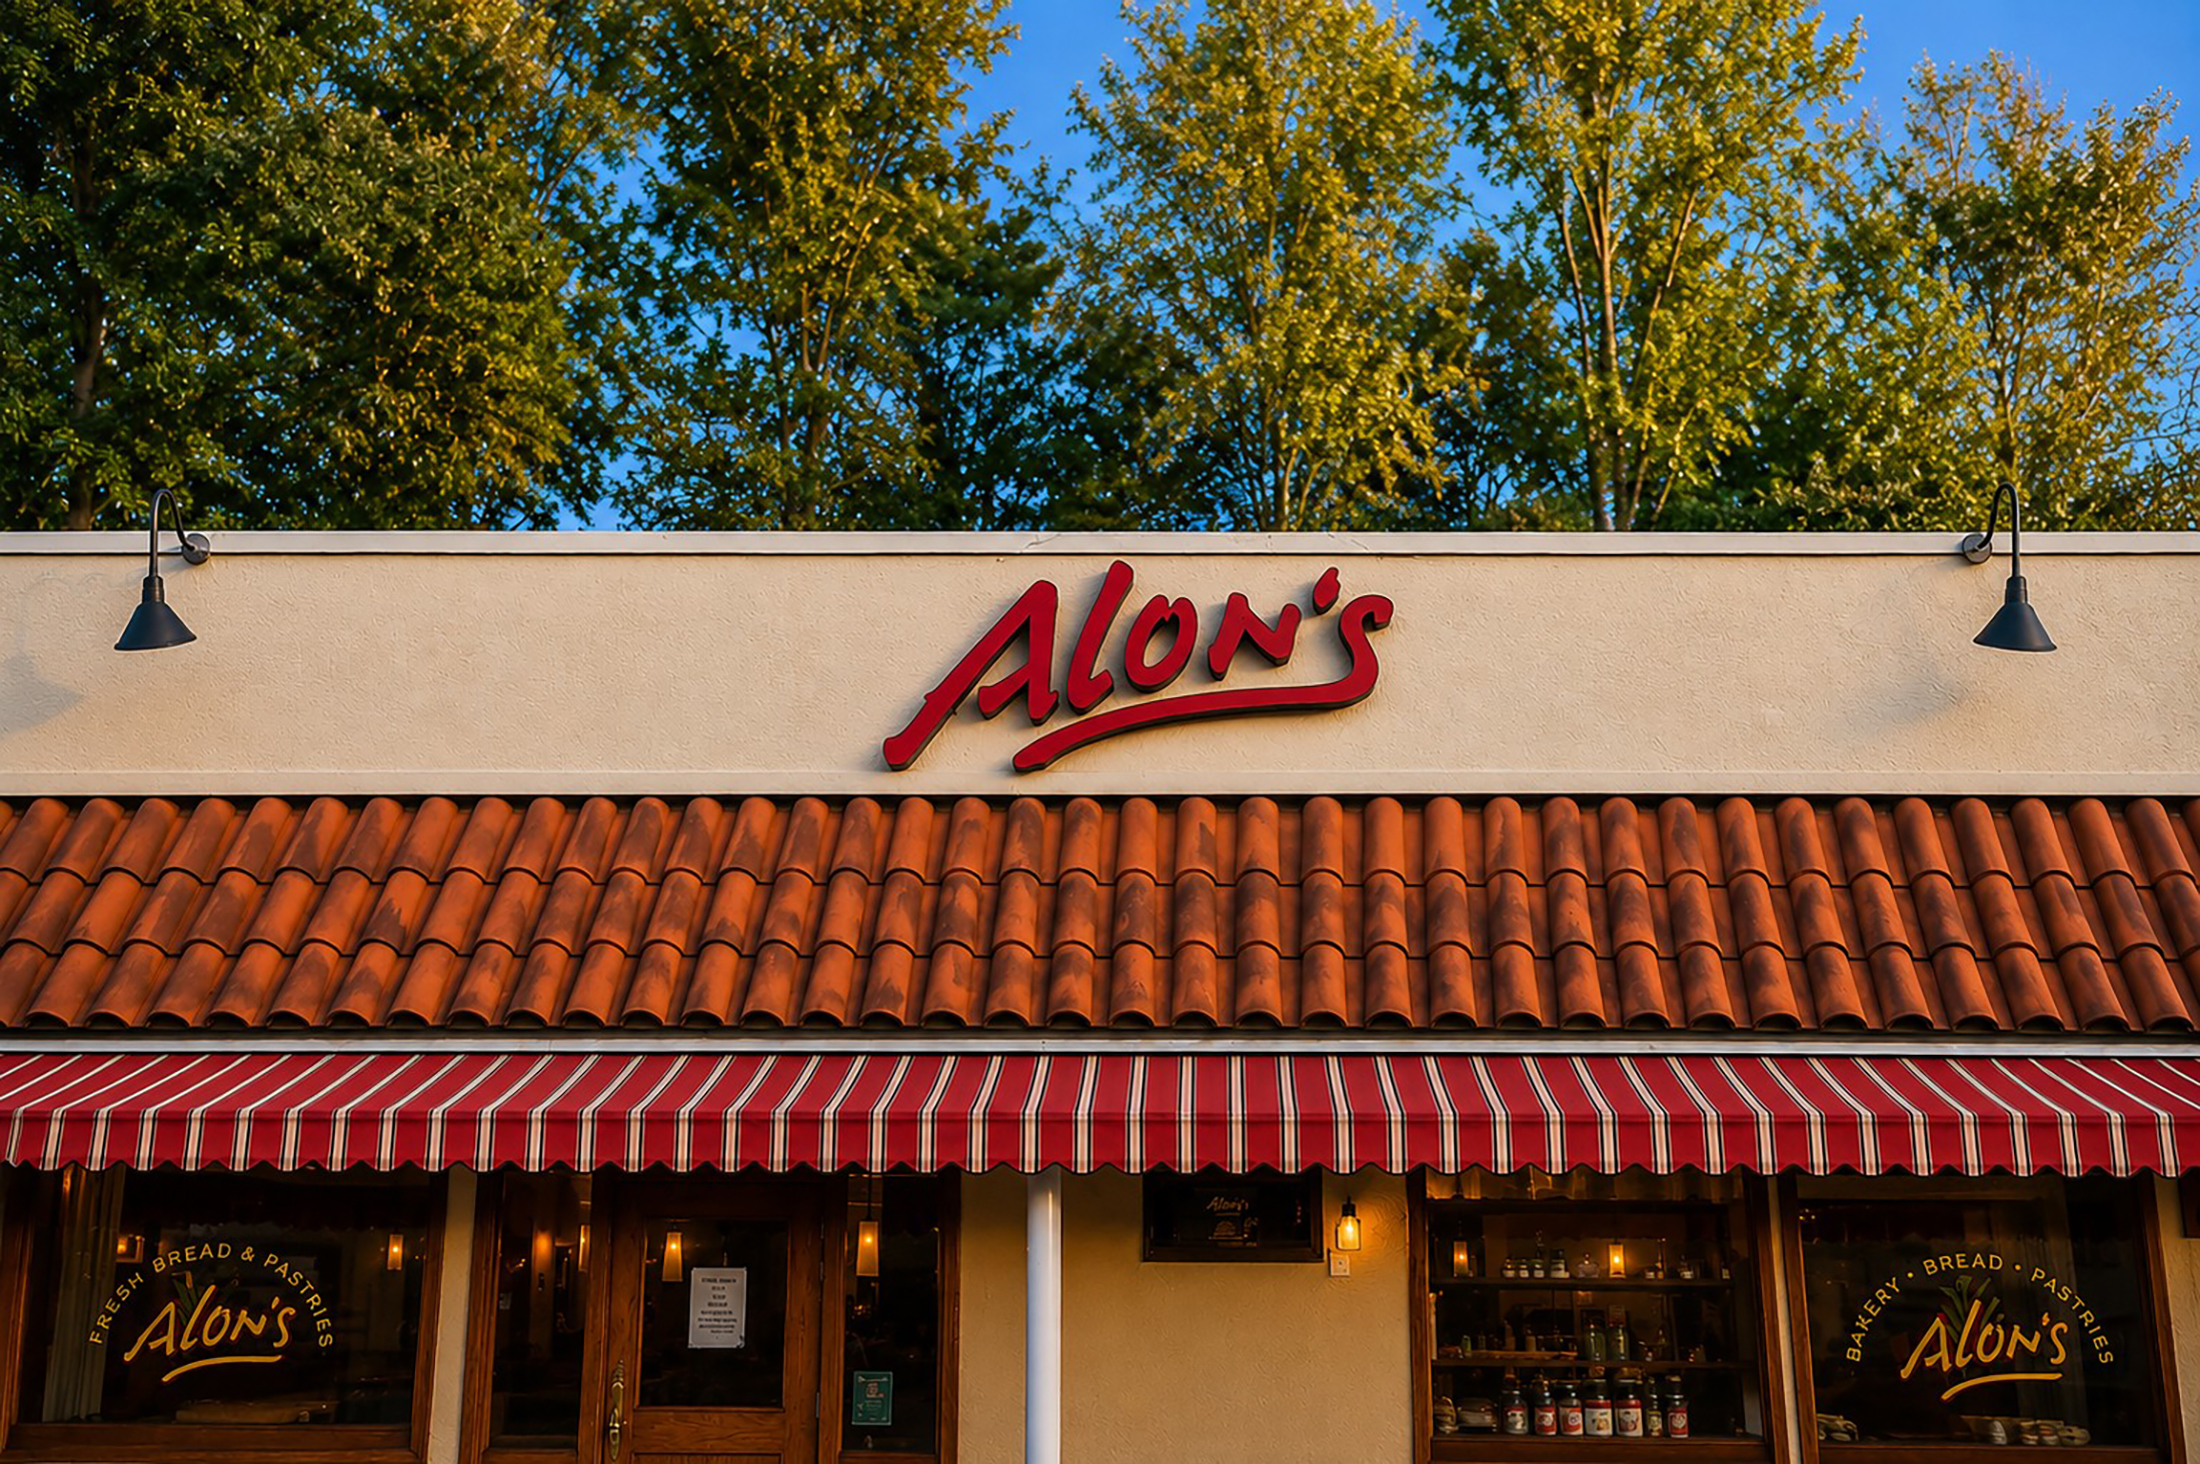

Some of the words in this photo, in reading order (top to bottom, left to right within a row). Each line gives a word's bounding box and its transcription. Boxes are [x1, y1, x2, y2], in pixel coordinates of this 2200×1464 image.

[90, 1273, 144, 1344] FRESH
[153, 1243, 232, 1273] BREAD
[241, 1246, 255, 1262] &
[264, 1253, 334, 1348] PASTRIES
[1846, 1277, 1901, 1362] BAKERY
[1923, 1253, 2003, 1276] BREAD
[2030, 1267, 2114, 1364] PASTRIES
